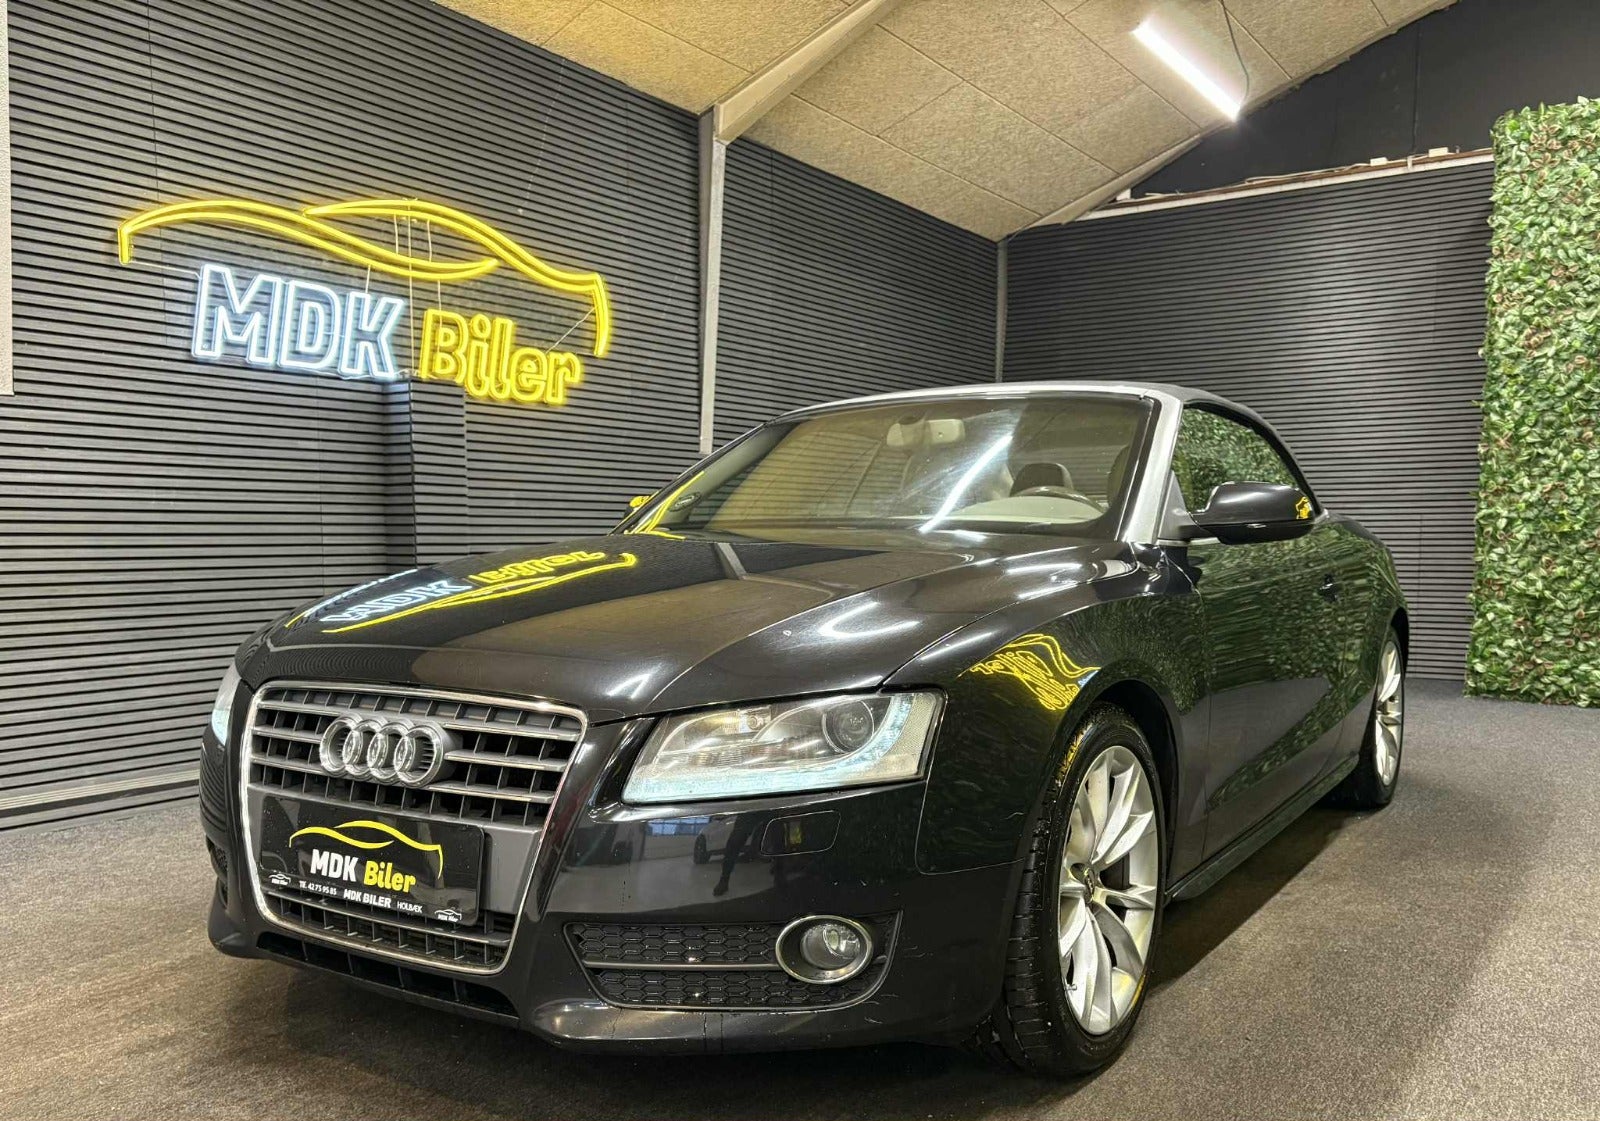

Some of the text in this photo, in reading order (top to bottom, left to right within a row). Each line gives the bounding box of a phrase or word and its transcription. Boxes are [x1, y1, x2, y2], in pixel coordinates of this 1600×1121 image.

[191, 262, 582, 404] MDK Biler
[310, 848, 417, 893] MDK Biler
[343, 888, 392, 909] MDK BILER
